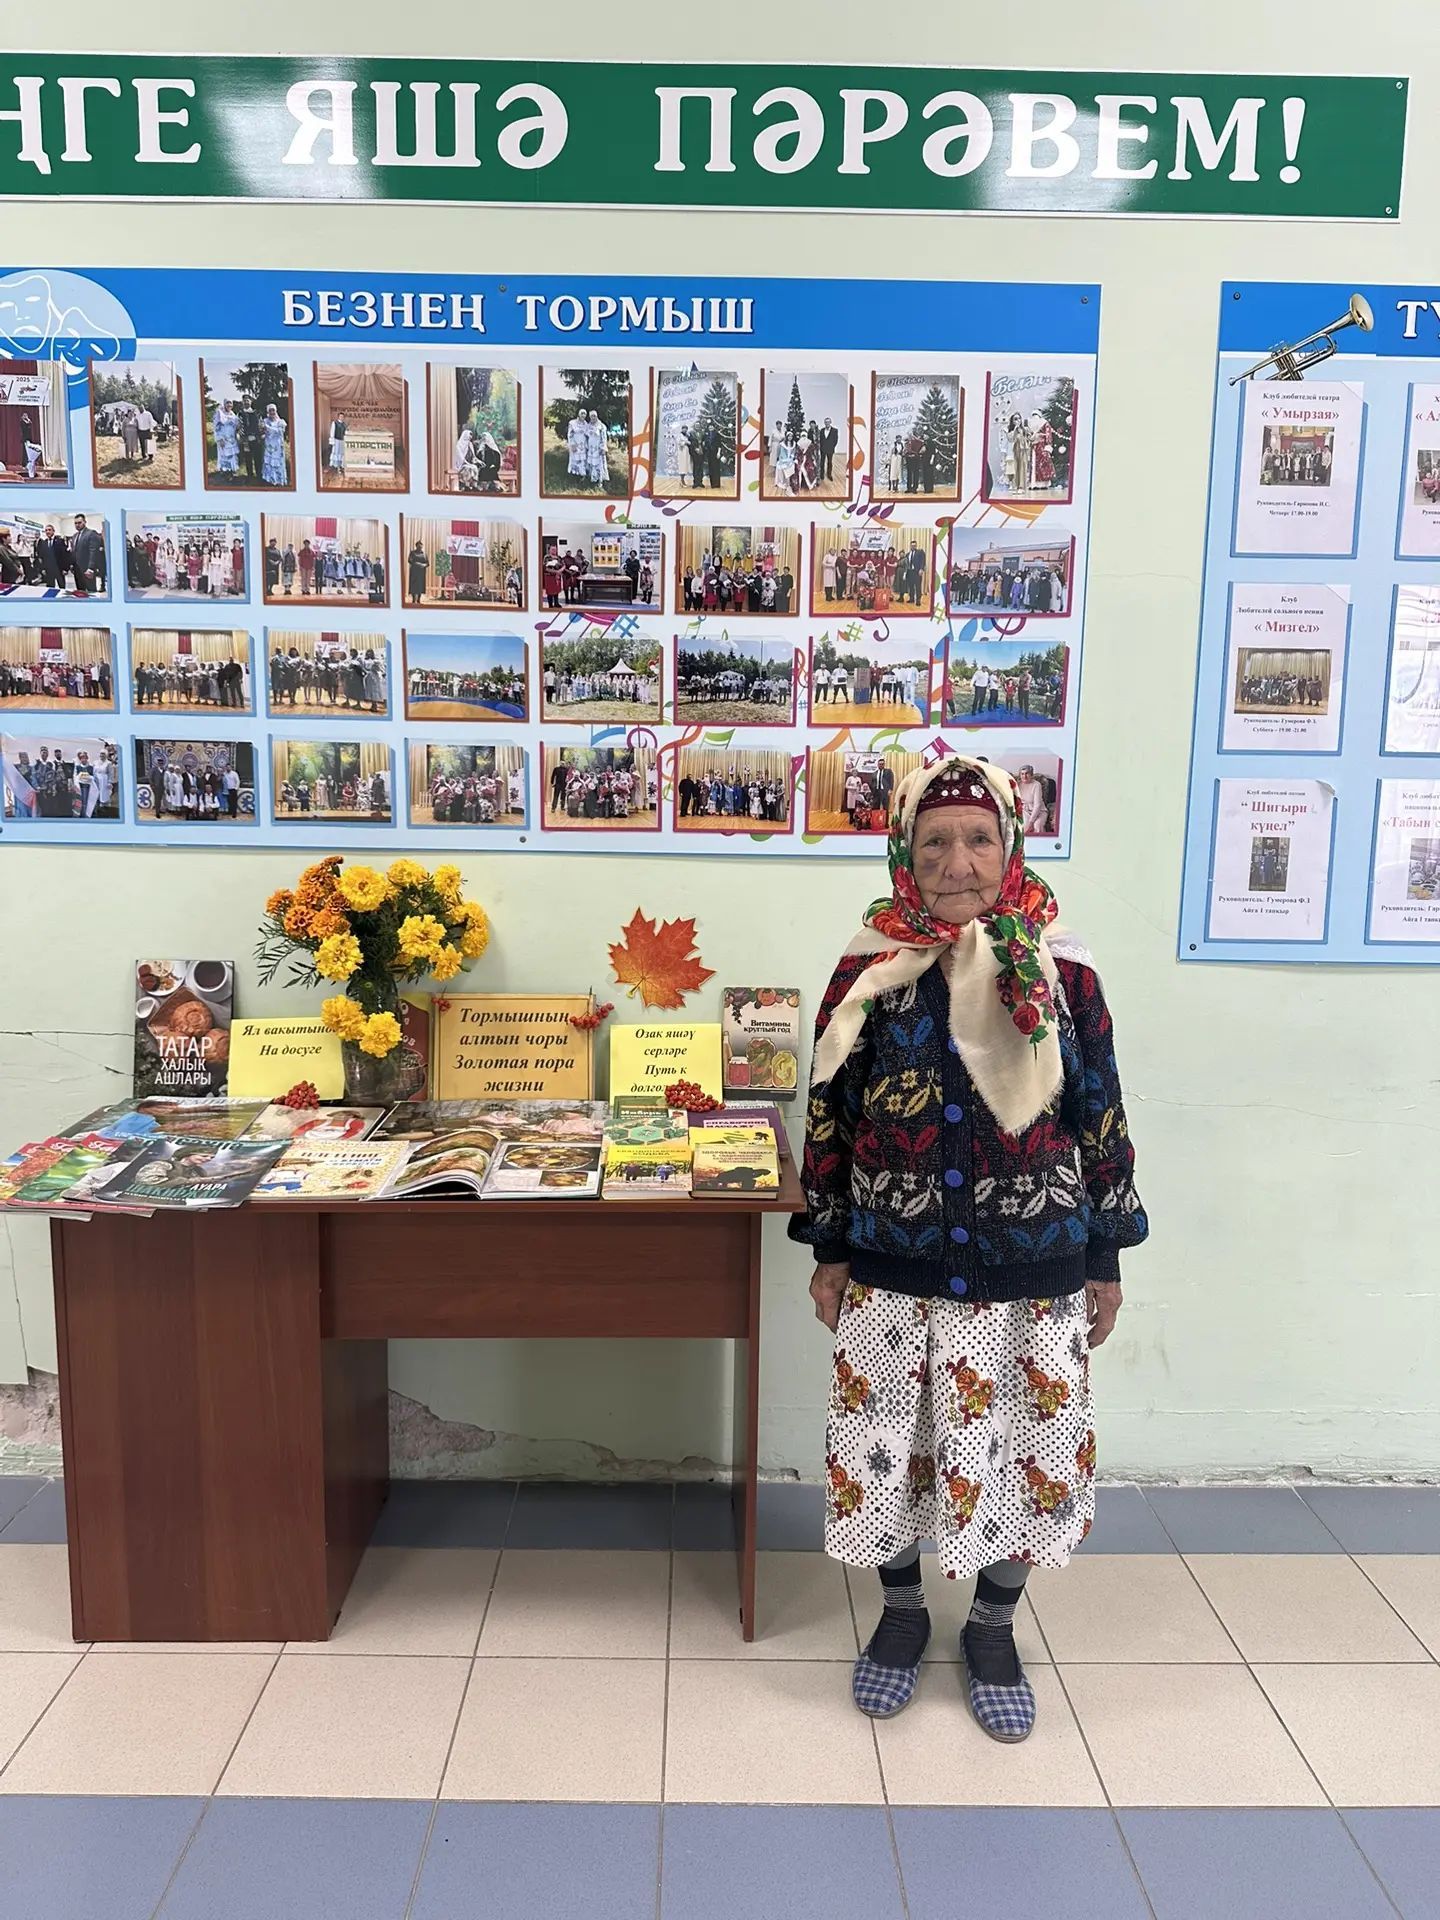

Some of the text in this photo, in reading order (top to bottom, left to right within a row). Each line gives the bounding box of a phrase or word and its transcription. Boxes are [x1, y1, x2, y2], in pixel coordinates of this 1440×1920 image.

[282, 80, 569, 170] ЯШӘ
[654, 86, 1306, 184] ПӘРӘВЕМ!
[282, 289, 754, 335] БЕЗНЕҢ ТОРМЫШ
[1281, 392, 1317, 401] любителей
[1318, 395, 1340, 403] театра
[345, 440, 392, 450] ТАТАРСТАН
[1280, 595, 1298, 604] Клуб
[1236, 607, 1272, 615] Любителей
[1265, 620, 1320, 633] Мизгел»
[1402, 792, 1419, 800] Клуб
[460, 1008, 570, 1027] Тормышның
[751, 1019, 791, 1027] Витамины
[242, 1024, 260, 1036] Ял
[635, 1028, 696, 1041] Озак яшәү
[743, 1026, 776, 1034] круглый
[156, 1036, 213, 1058] ТАТАР
[460, 1033, 569, 1049] алтын чоры
[259, 1044, 322, 1057] На досуге
[644, 1047, 688, 1058] серләре
[161, 1058, 207, 1072] ХАЛЫК
[453, 1054, 575, 1073] Золотая пора
[645, 1064, 688, 1077] Путь к
[154, 1072, 212, 1086] АШЛАРЫ
[484, 1080, 545, 1092] жизни
